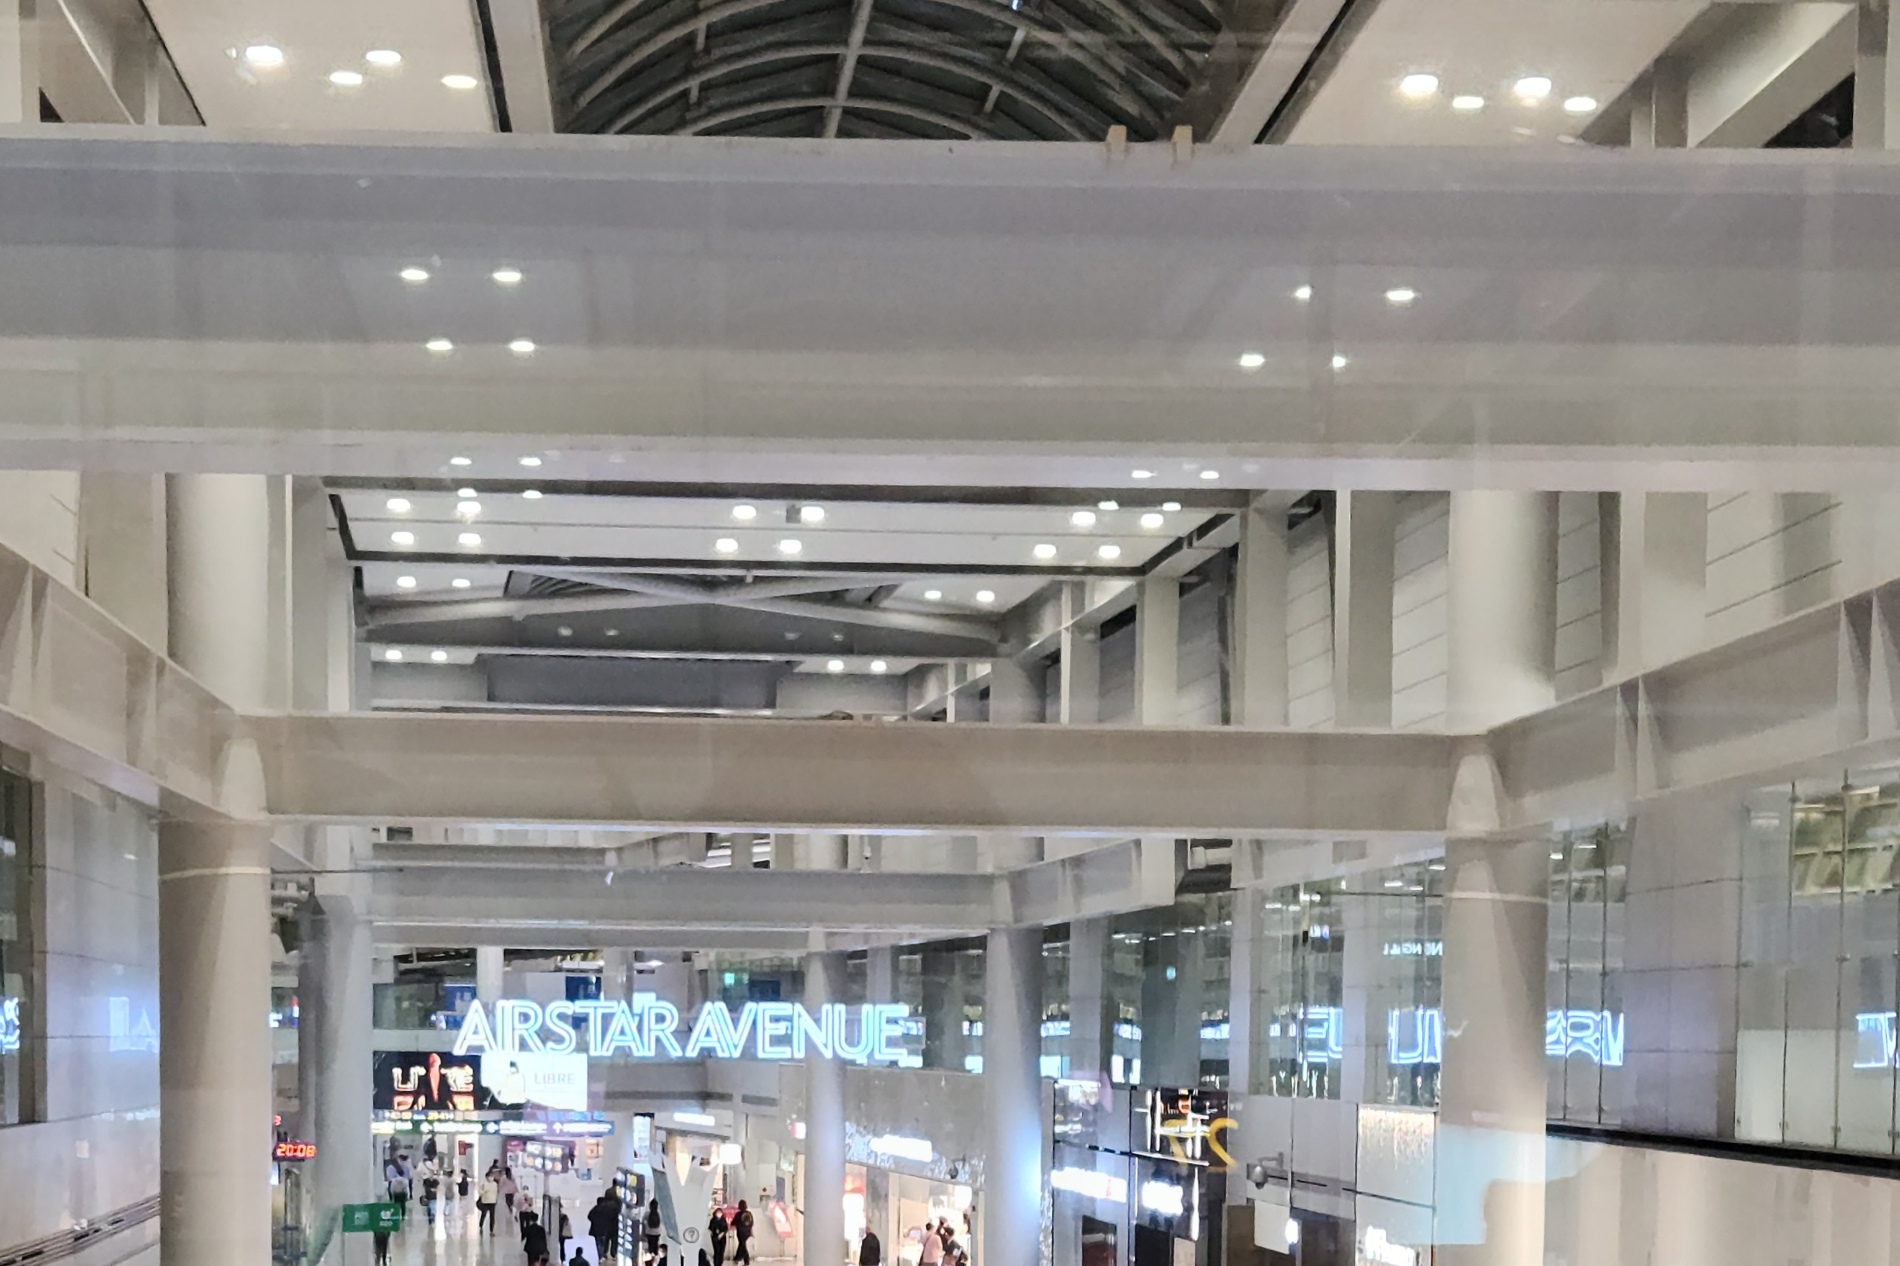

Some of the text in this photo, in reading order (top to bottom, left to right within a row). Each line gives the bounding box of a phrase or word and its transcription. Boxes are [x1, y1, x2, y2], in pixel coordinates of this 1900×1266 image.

[453, 999, 910, 1060] AIRSTAR AVENUE
[533, 1072, 576, 1086] LIBRE
[276, 1143, 317, 1158] 20:08
